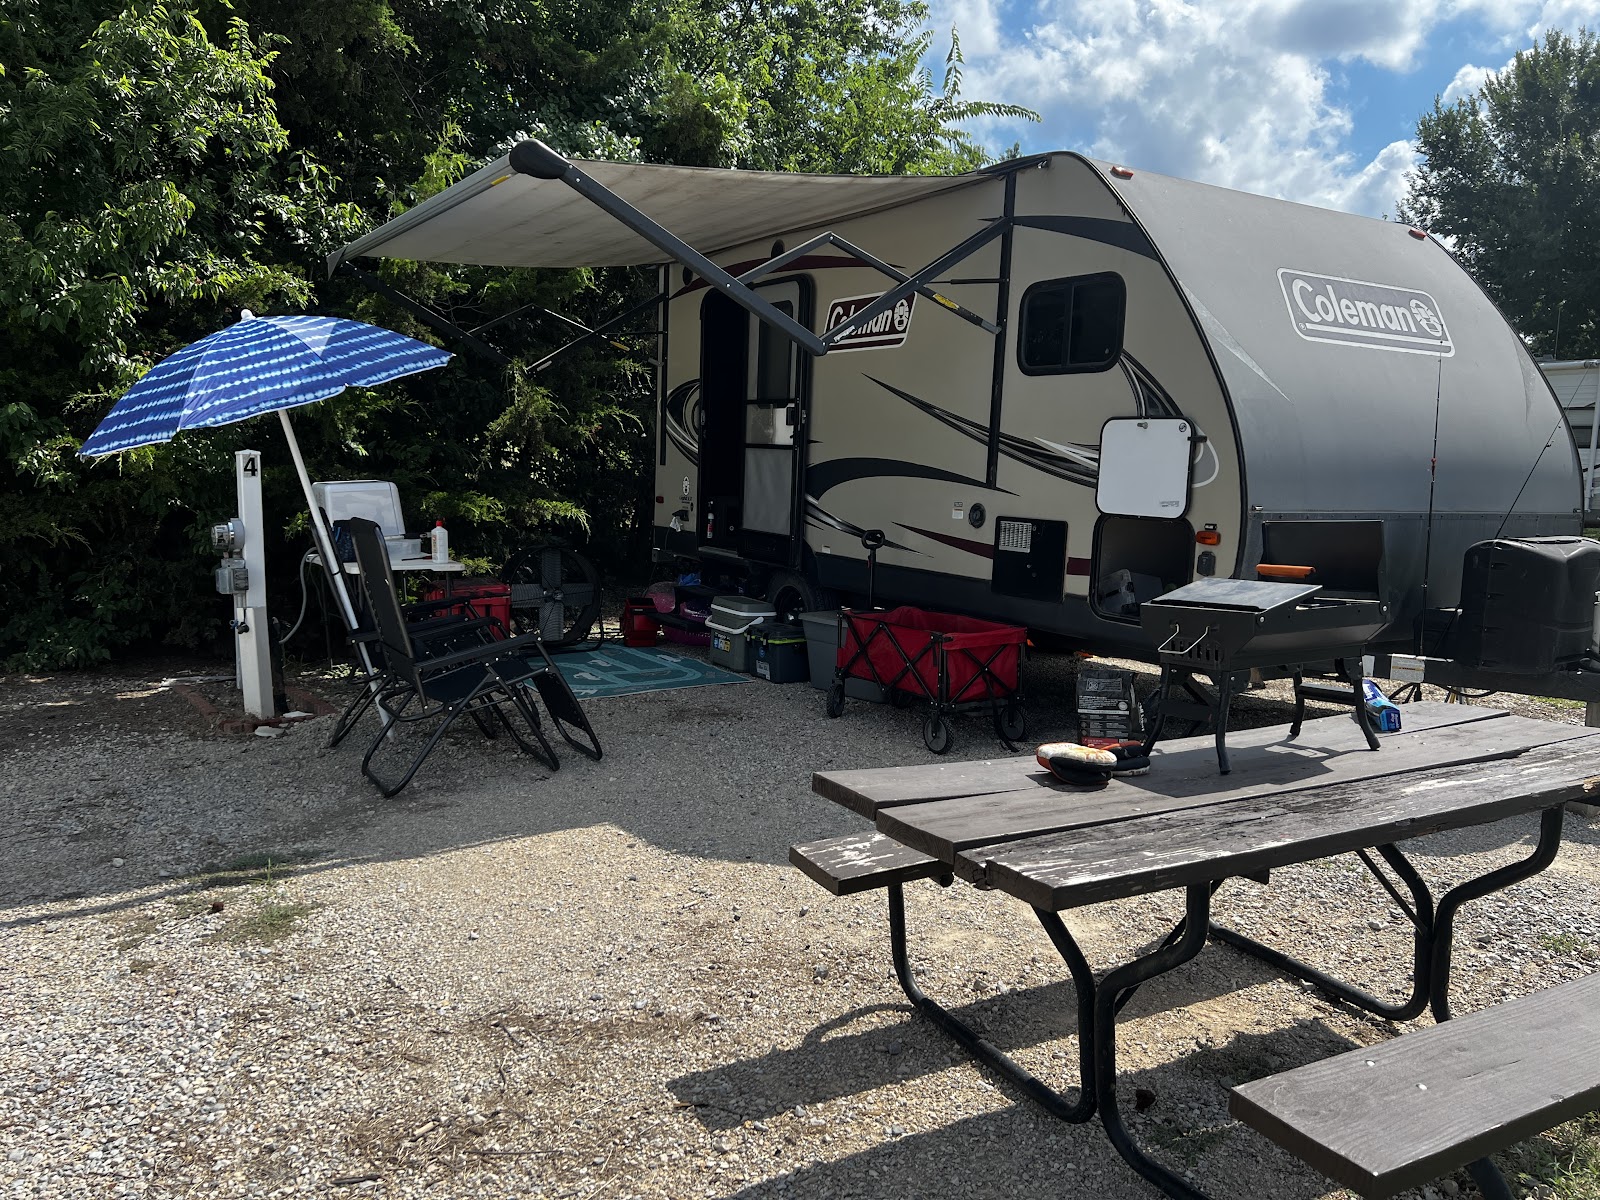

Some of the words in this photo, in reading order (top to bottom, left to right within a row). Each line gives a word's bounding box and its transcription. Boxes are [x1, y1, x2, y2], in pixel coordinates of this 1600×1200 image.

[829, 304, 893, 336] Cman
[1292, 278, 1418, 333] Coleman
[244, 457, 257, 476] 4
